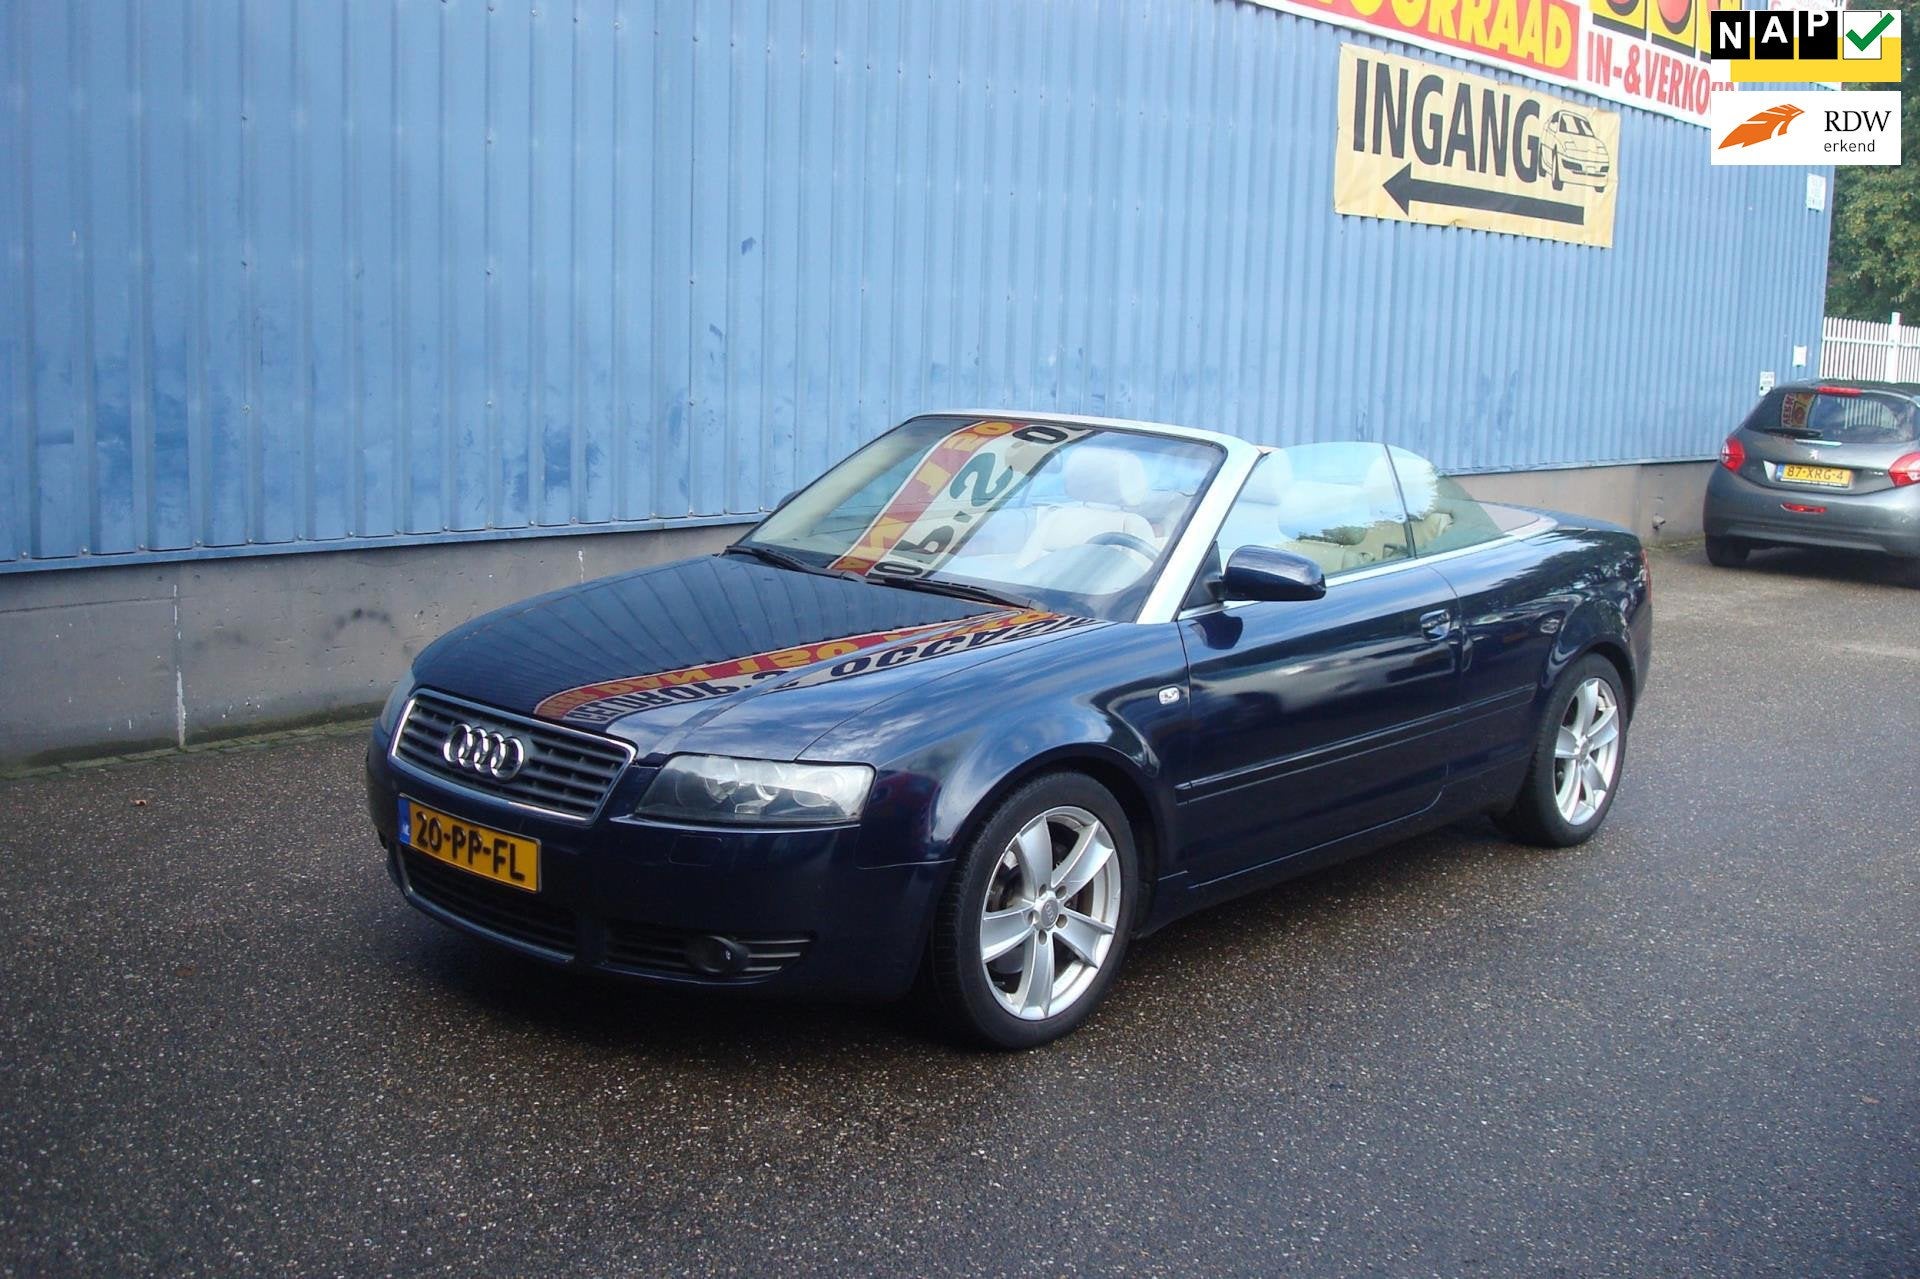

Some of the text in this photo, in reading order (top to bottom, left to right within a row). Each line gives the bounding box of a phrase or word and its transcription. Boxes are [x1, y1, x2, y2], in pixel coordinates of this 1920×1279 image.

[1318, 0, 1572, 69] RRAAD
[1353, 58, 1540, 183] INGANG
[415, 811, 526, 881] 20-PP-FL
